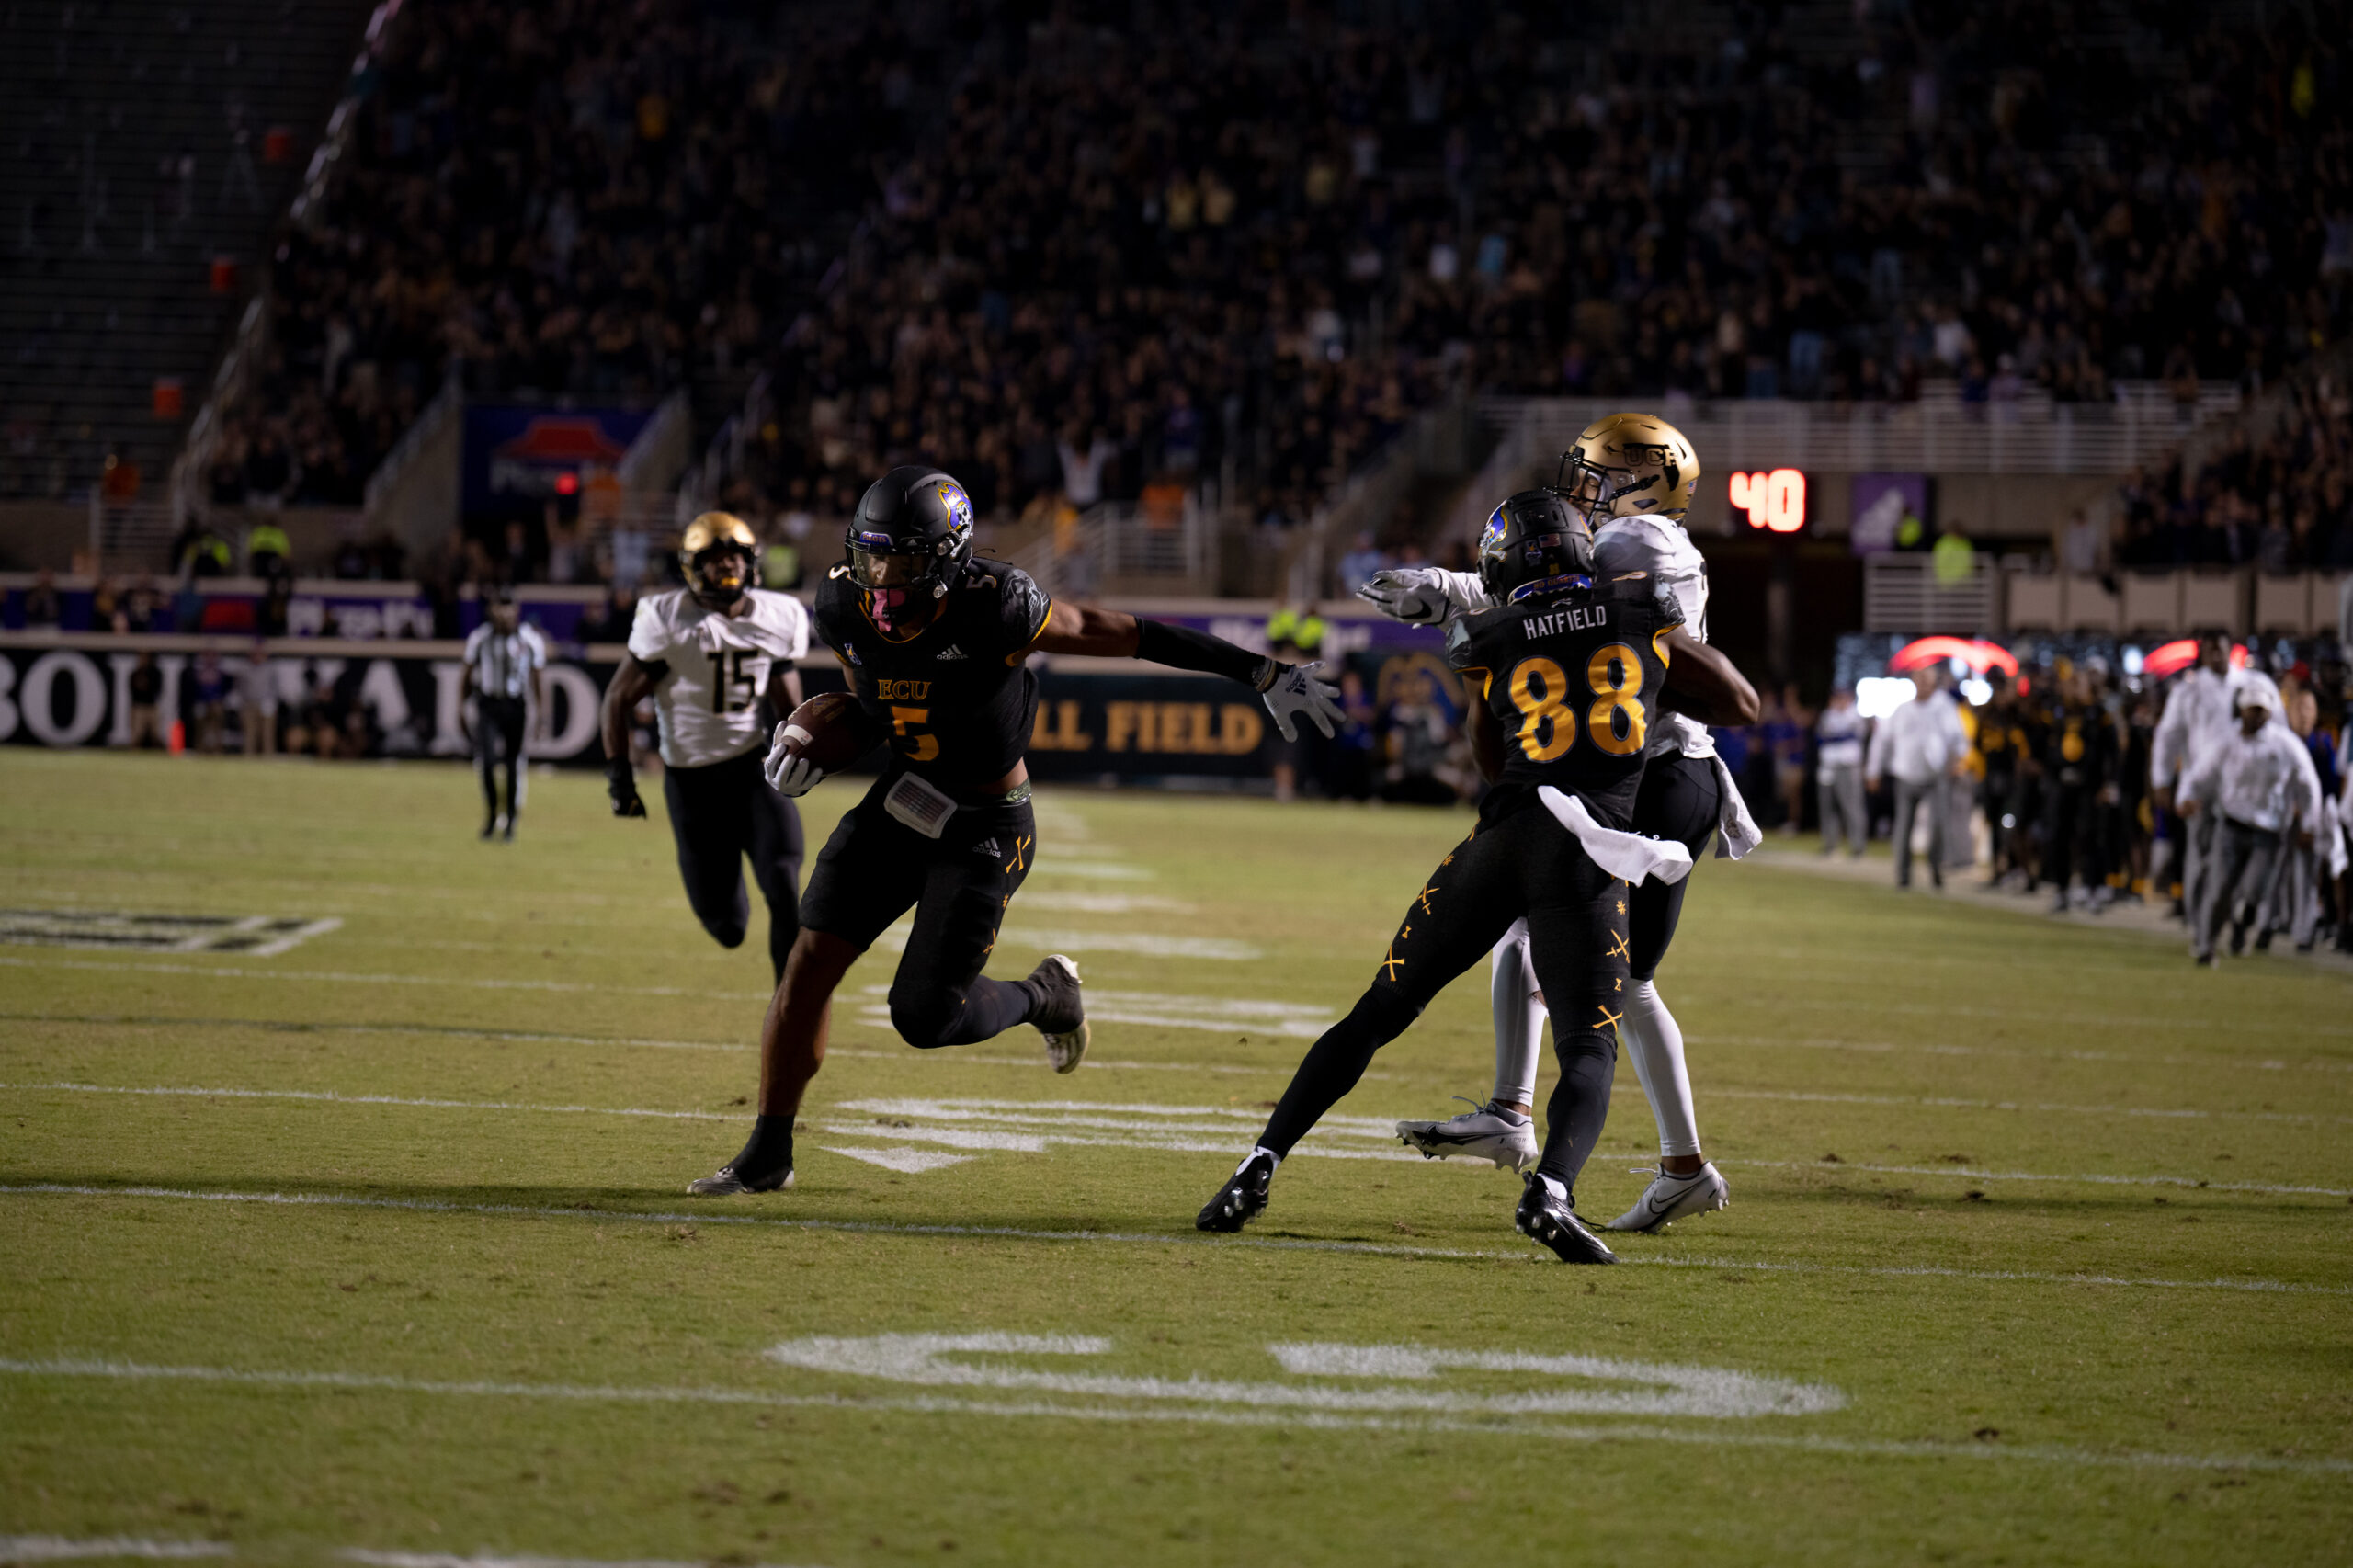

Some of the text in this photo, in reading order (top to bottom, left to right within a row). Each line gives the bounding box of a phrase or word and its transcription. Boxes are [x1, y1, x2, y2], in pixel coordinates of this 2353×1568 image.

[1729, 468, 1806, 532] 40
[1523, 605, 1607, 641] HATFIELD
[708, 649, 759, 714] 15
[877, 678, 932, 700] ECU
[1508, 642, 1646, 764] 88
[891, 705, 940, 761] 5
[1106, 699, 1265, 756] FIELD
[972, 845, 1002, 858] adidas
